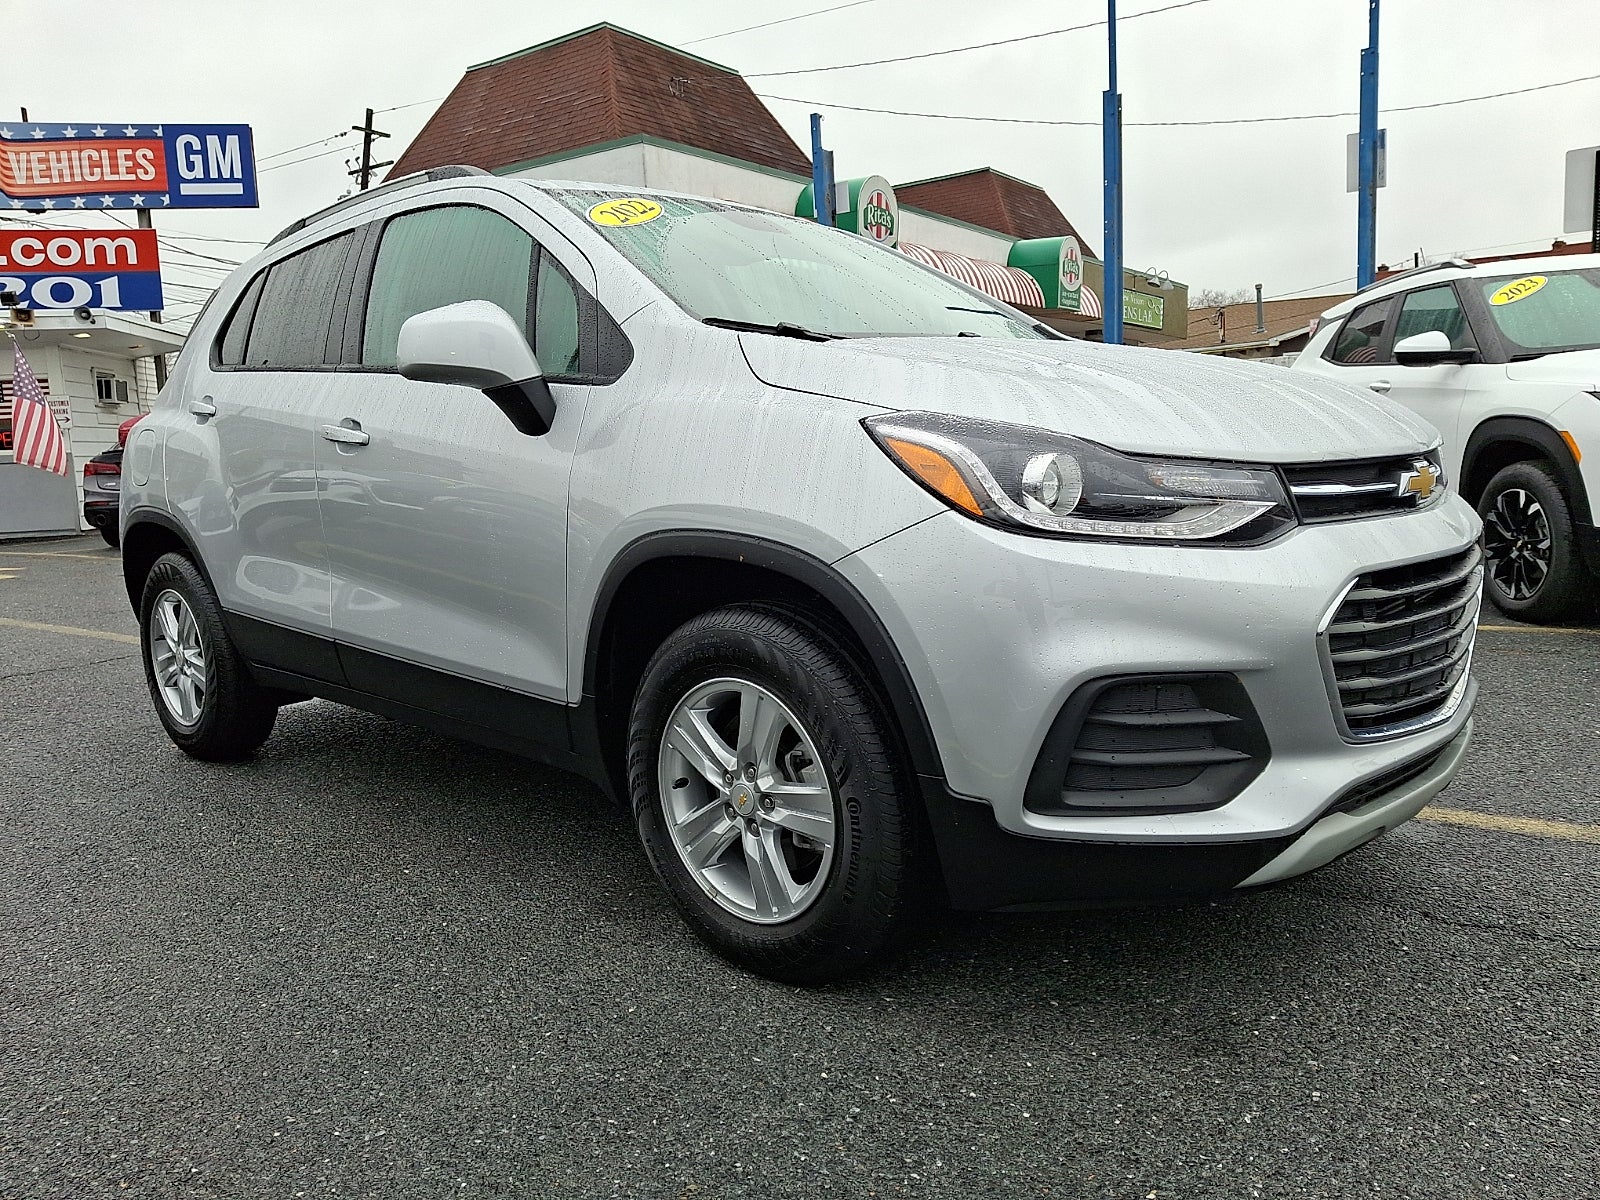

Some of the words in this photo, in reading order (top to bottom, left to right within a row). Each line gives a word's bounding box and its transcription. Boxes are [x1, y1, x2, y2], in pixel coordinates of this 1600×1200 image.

[9, 149, 155, 184] VEHICLES
[175, 134, 242, 180] GM
[600, 200, 656, 223] 2022
[867, 204, 892, 228] Rita's
[1499, 278, 1539, 301] 2023
[1123, 305, 1138, 320] ENS
[1138, 308, 1153, 323] LAB
